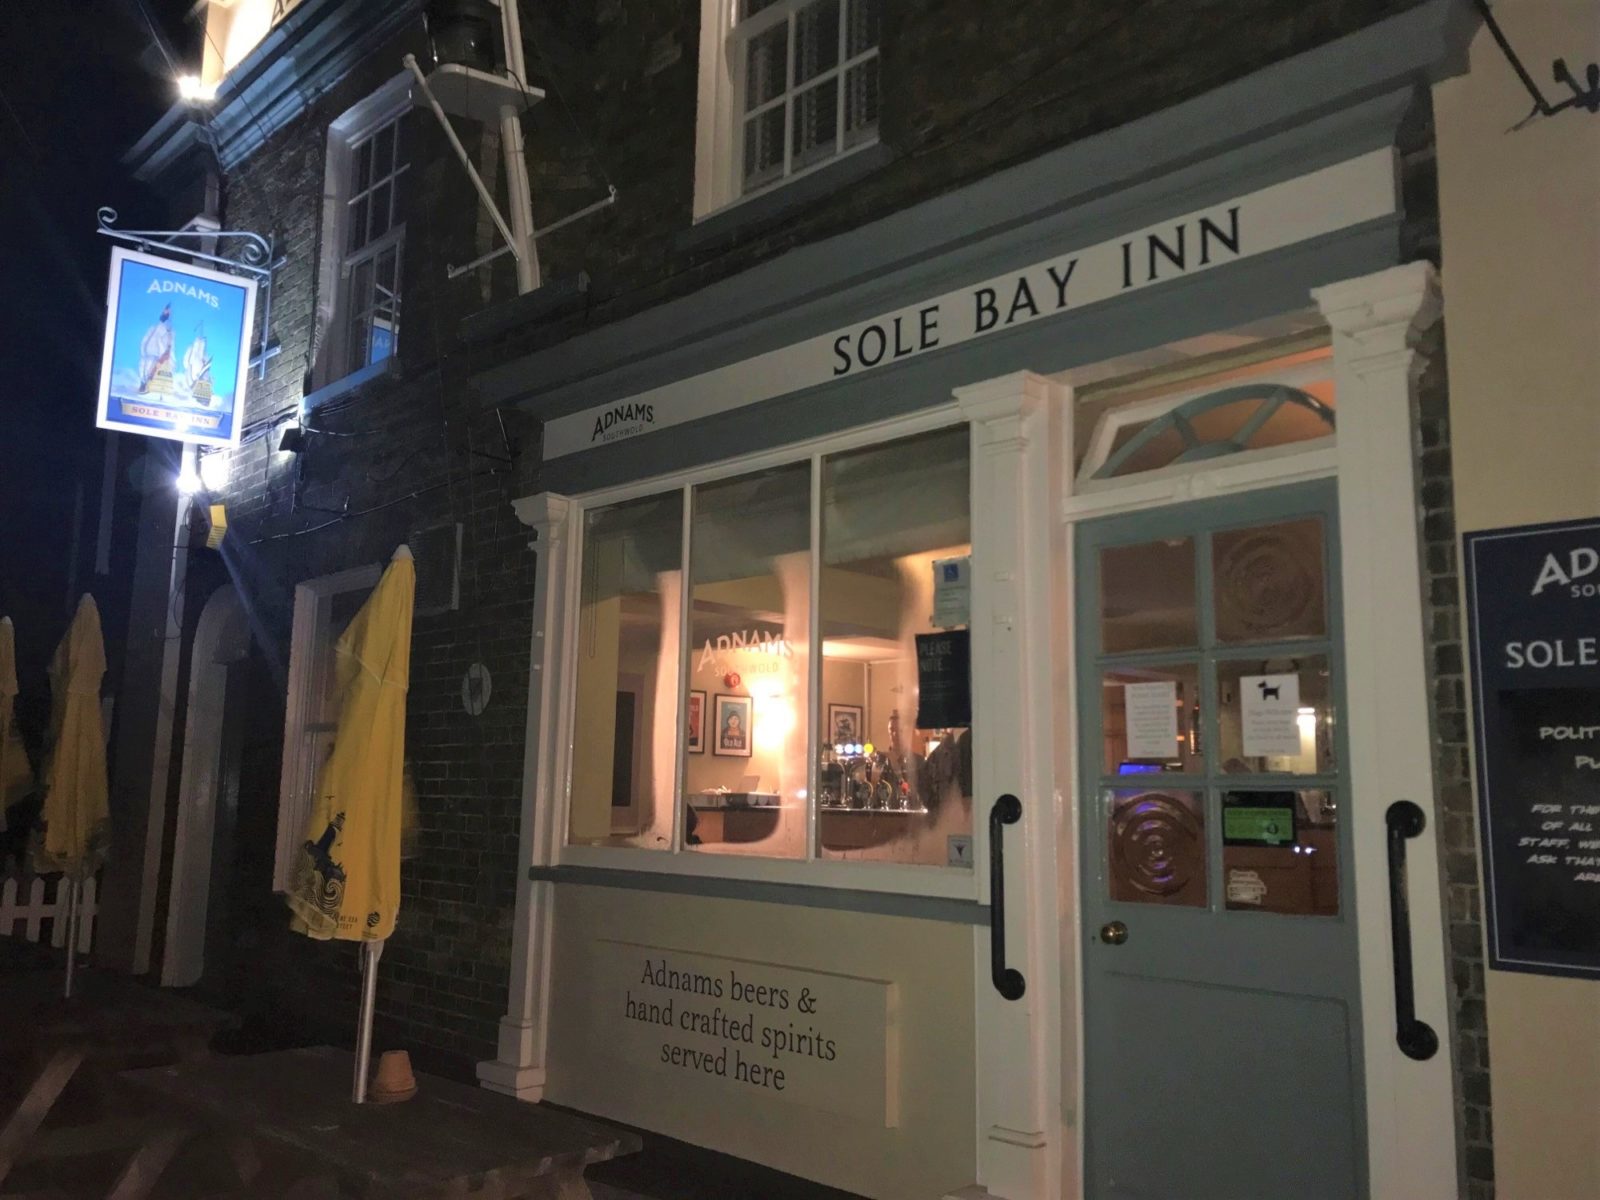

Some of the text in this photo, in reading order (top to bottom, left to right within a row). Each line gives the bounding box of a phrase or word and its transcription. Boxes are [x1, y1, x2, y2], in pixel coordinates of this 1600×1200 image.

[147, 278, 219, 308] ADNAMS
[833, 206, 1241, 376] SOLE BAY INN
[131, 406, 160, 418] SOLE
[592, 403, 654, 441] ADNAMS
[602, 424, 643, 442] SOUTHWOLD
[1571, 583, 1600, 598] SO
[697, 629, 794, 672] ADNAMS
[1505, 637, 1599, 669] SOLE
[1531, 804, 1562, 814] FOR
[1541, 821, 1592, 832] OF ALL
[1526, 854, 1558, 864] ASK
[641, 959, 817, 1014] Adnams beers &
[624, 990, 836, 1061] hand crafted spirits
[661, 1043, 785, 1091] served here
